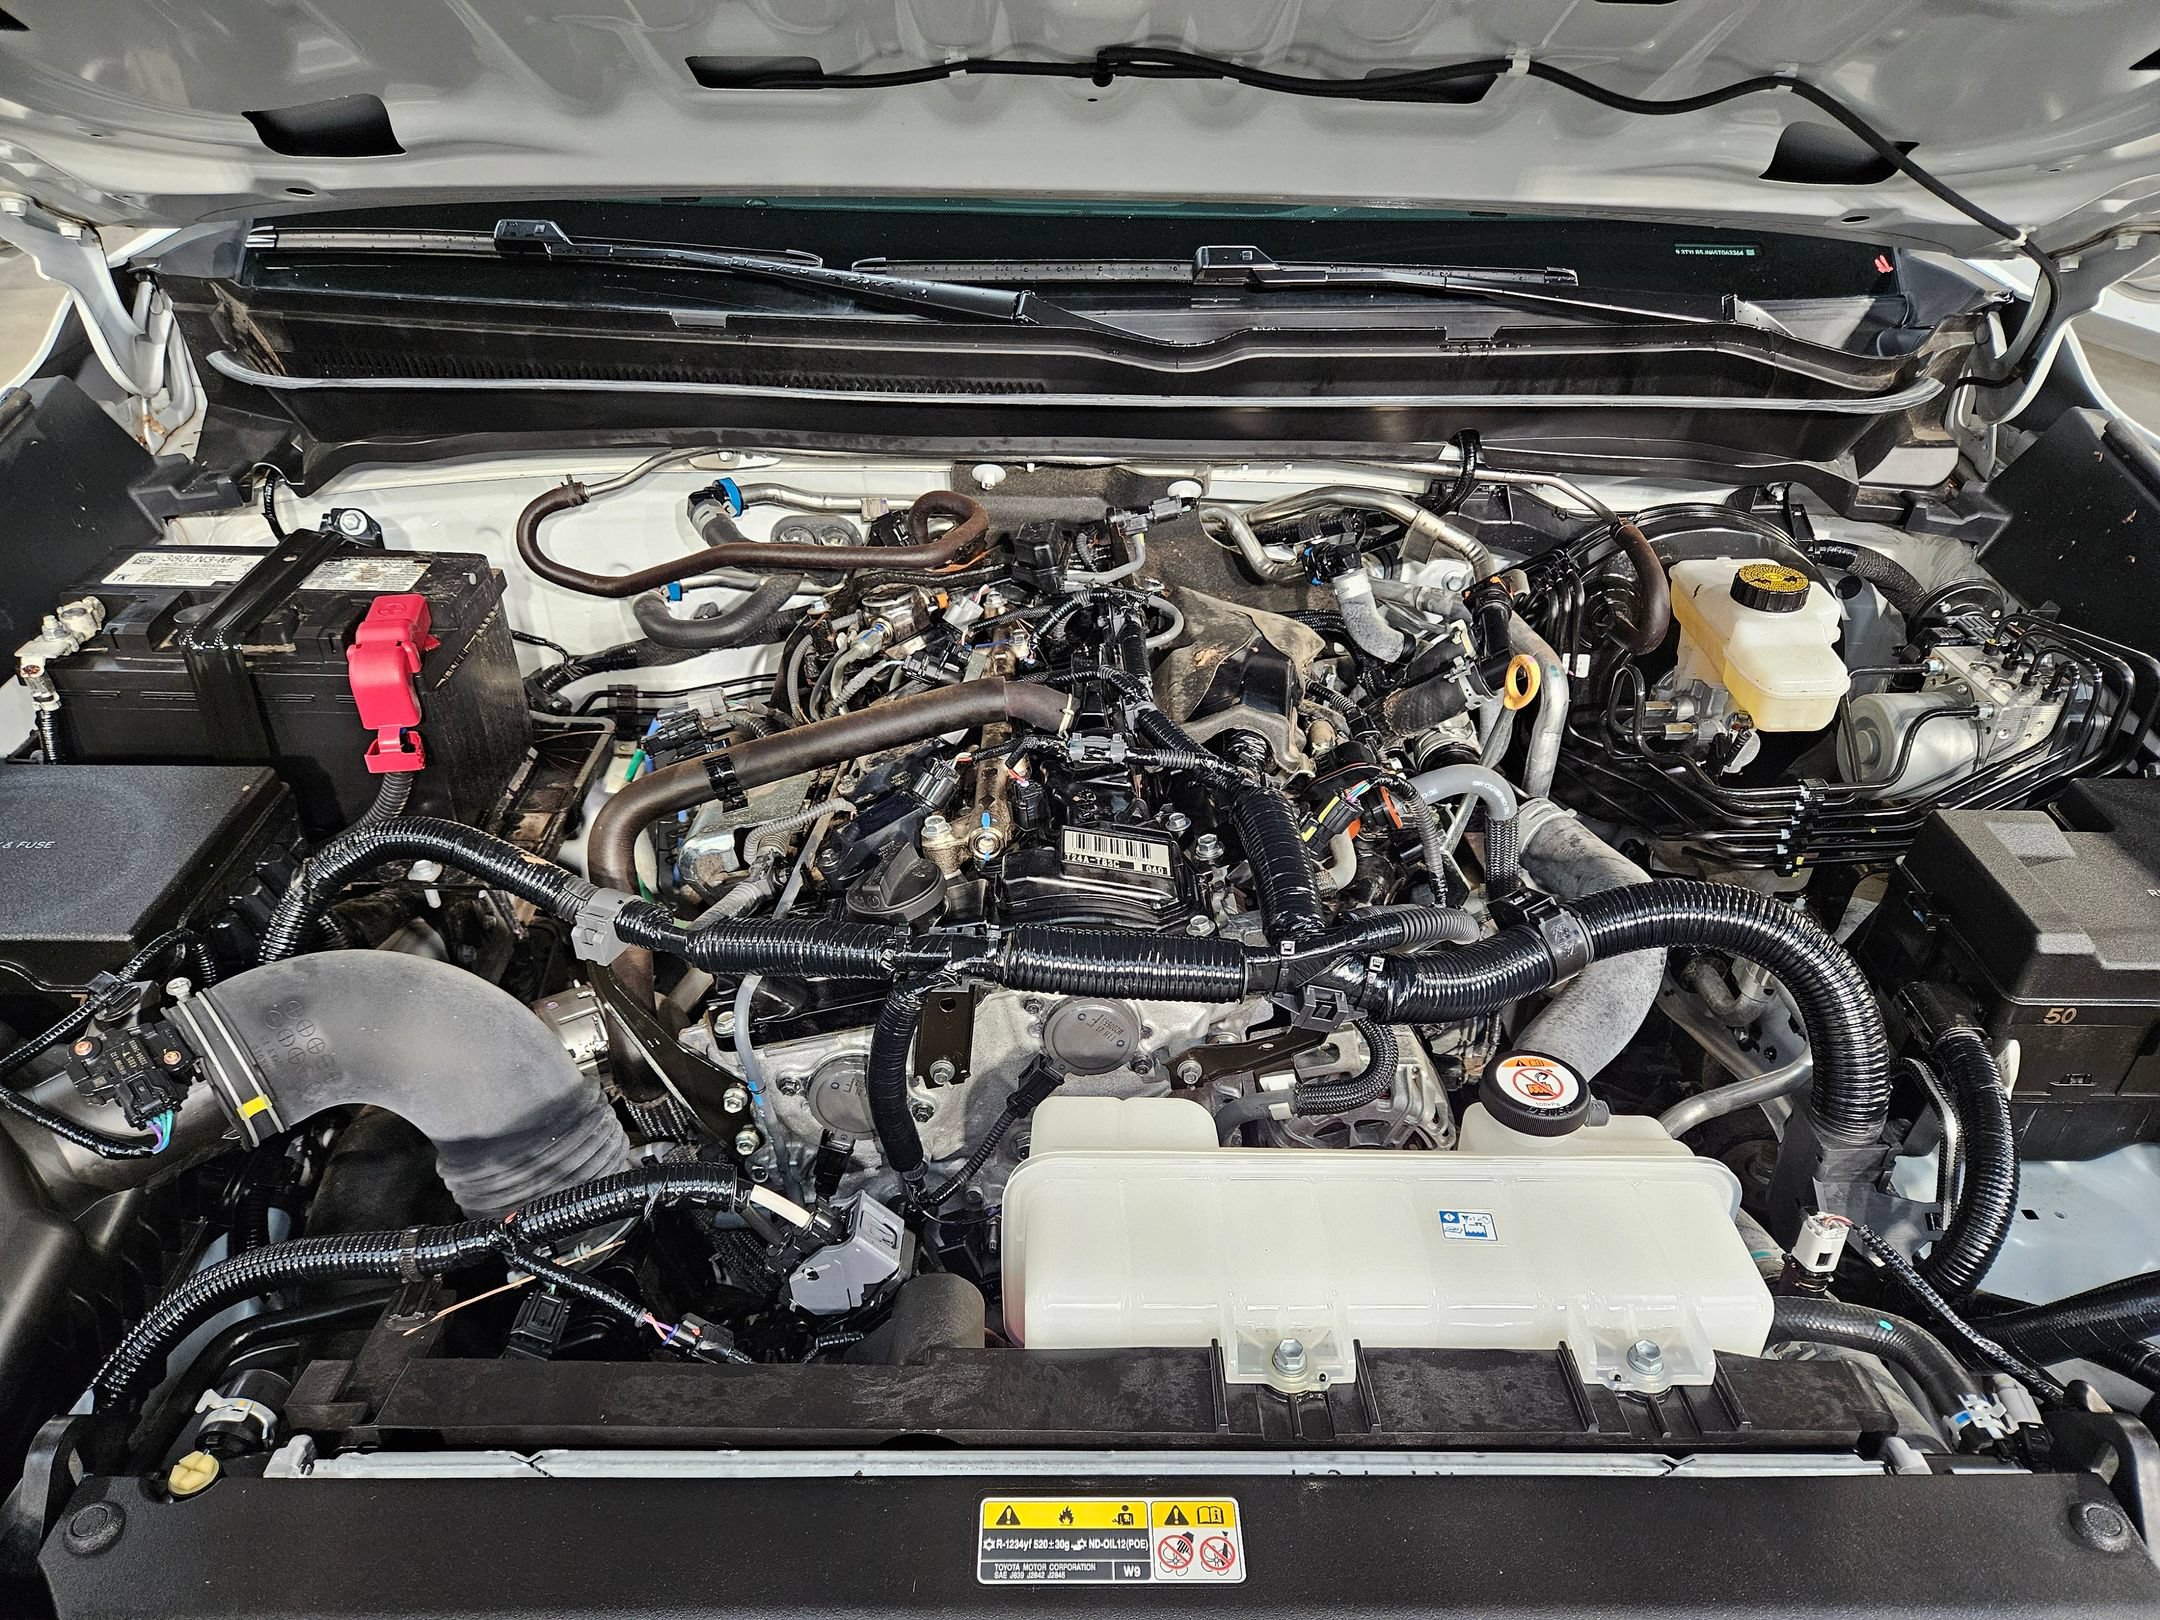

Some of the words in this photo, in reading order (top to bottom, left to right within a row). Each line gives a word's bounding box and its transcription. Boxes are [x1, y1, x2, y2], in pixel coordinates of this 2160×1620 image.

[16, 841, 56, 849] FUSE
[1064, 852, 1121, 869] T24A-T83C
[1146, 865, 1164, 875] 040
[2043, 1007, 2078, 1024] 50
[996, 1538, 1032, 1551] R-1234yf
[1034, 1538, 1070, 1551] 520±30g
[994, 1563, 1020, 1571] TOYOTA
[1022, 1563, 1047, 1571] MOTOR
[1048, 1563, 1096, 1571] CORPORATION
[1122, 1565, 1141, 1578] W9
[994, 1571, 1008, 1579] SAE
